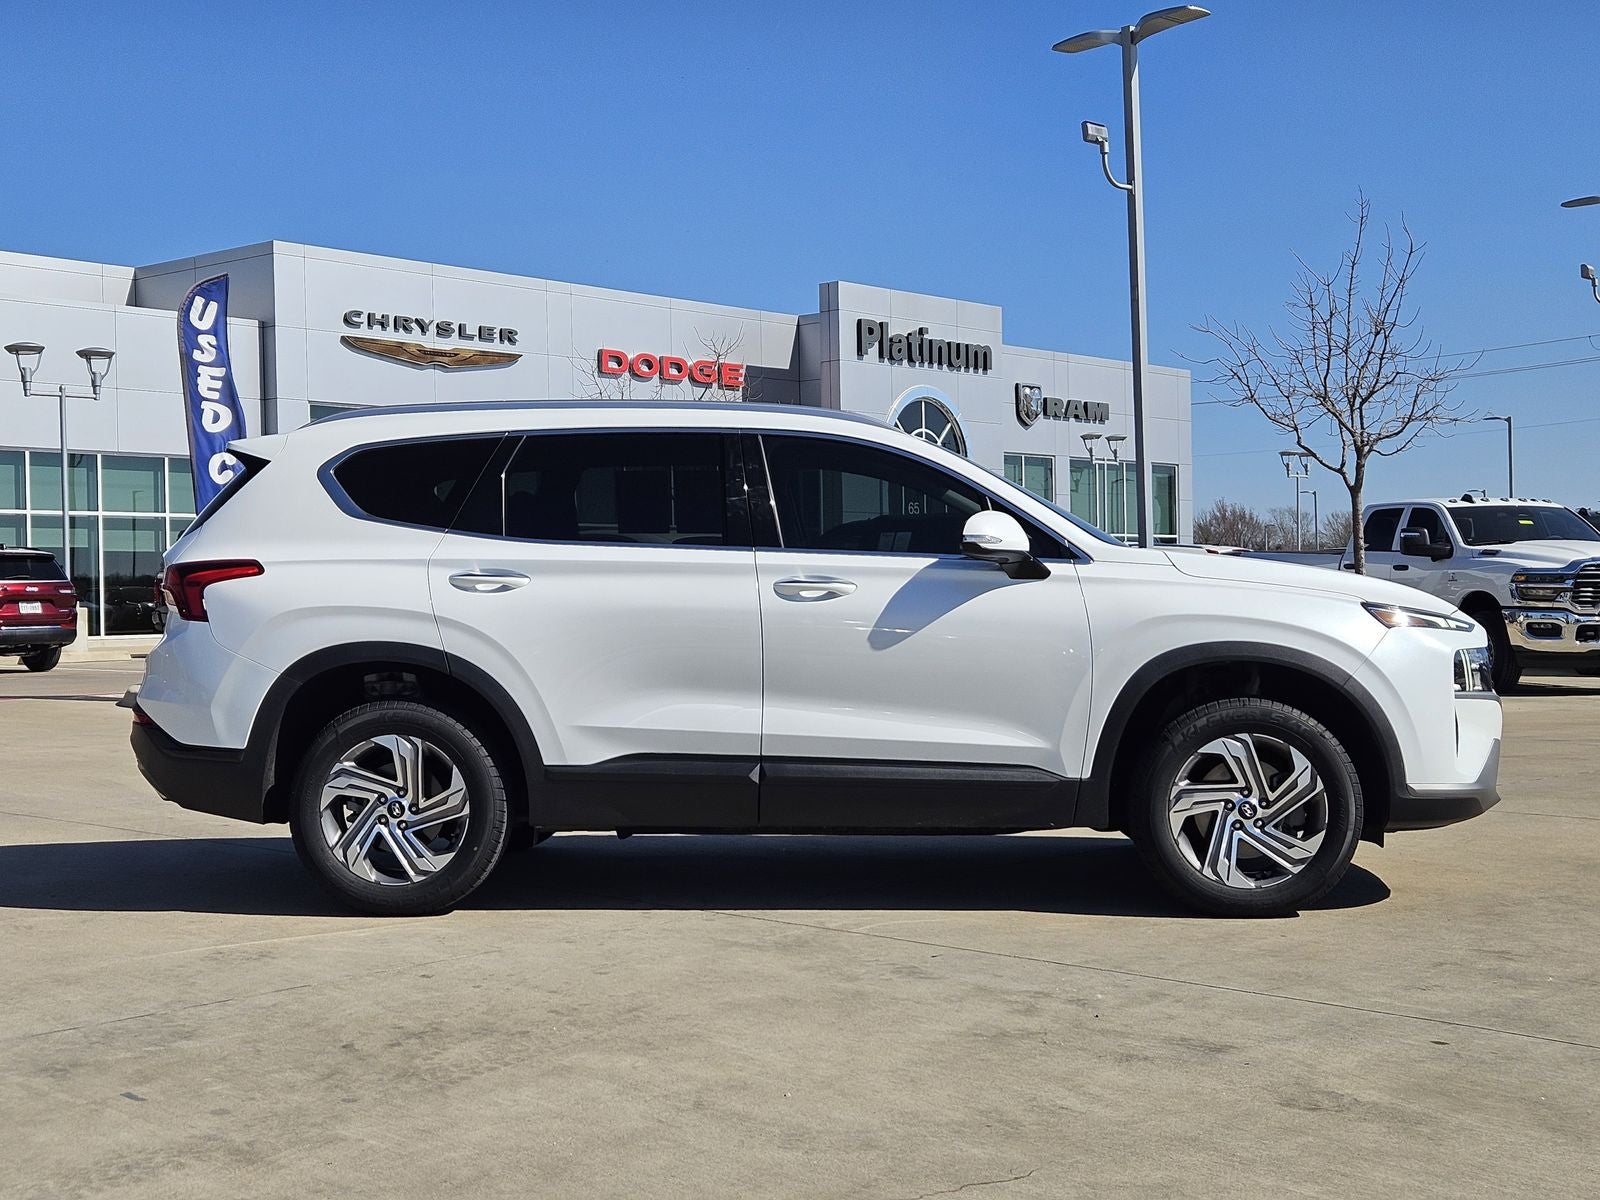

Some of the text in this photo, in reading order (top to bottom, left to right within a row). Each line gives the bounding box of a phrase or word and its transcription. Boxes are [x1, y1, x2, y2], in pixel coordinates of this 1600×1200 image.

[342, 309, 519, 346] CHRYSLER
[856, 318, 993, 375] Platinum
[189, 295, 233, 434] USED
[598, 348, 746, 390] DODGE
[1043, 397, 1110, 425] RAM
[908, 502, 919, 514] 65
